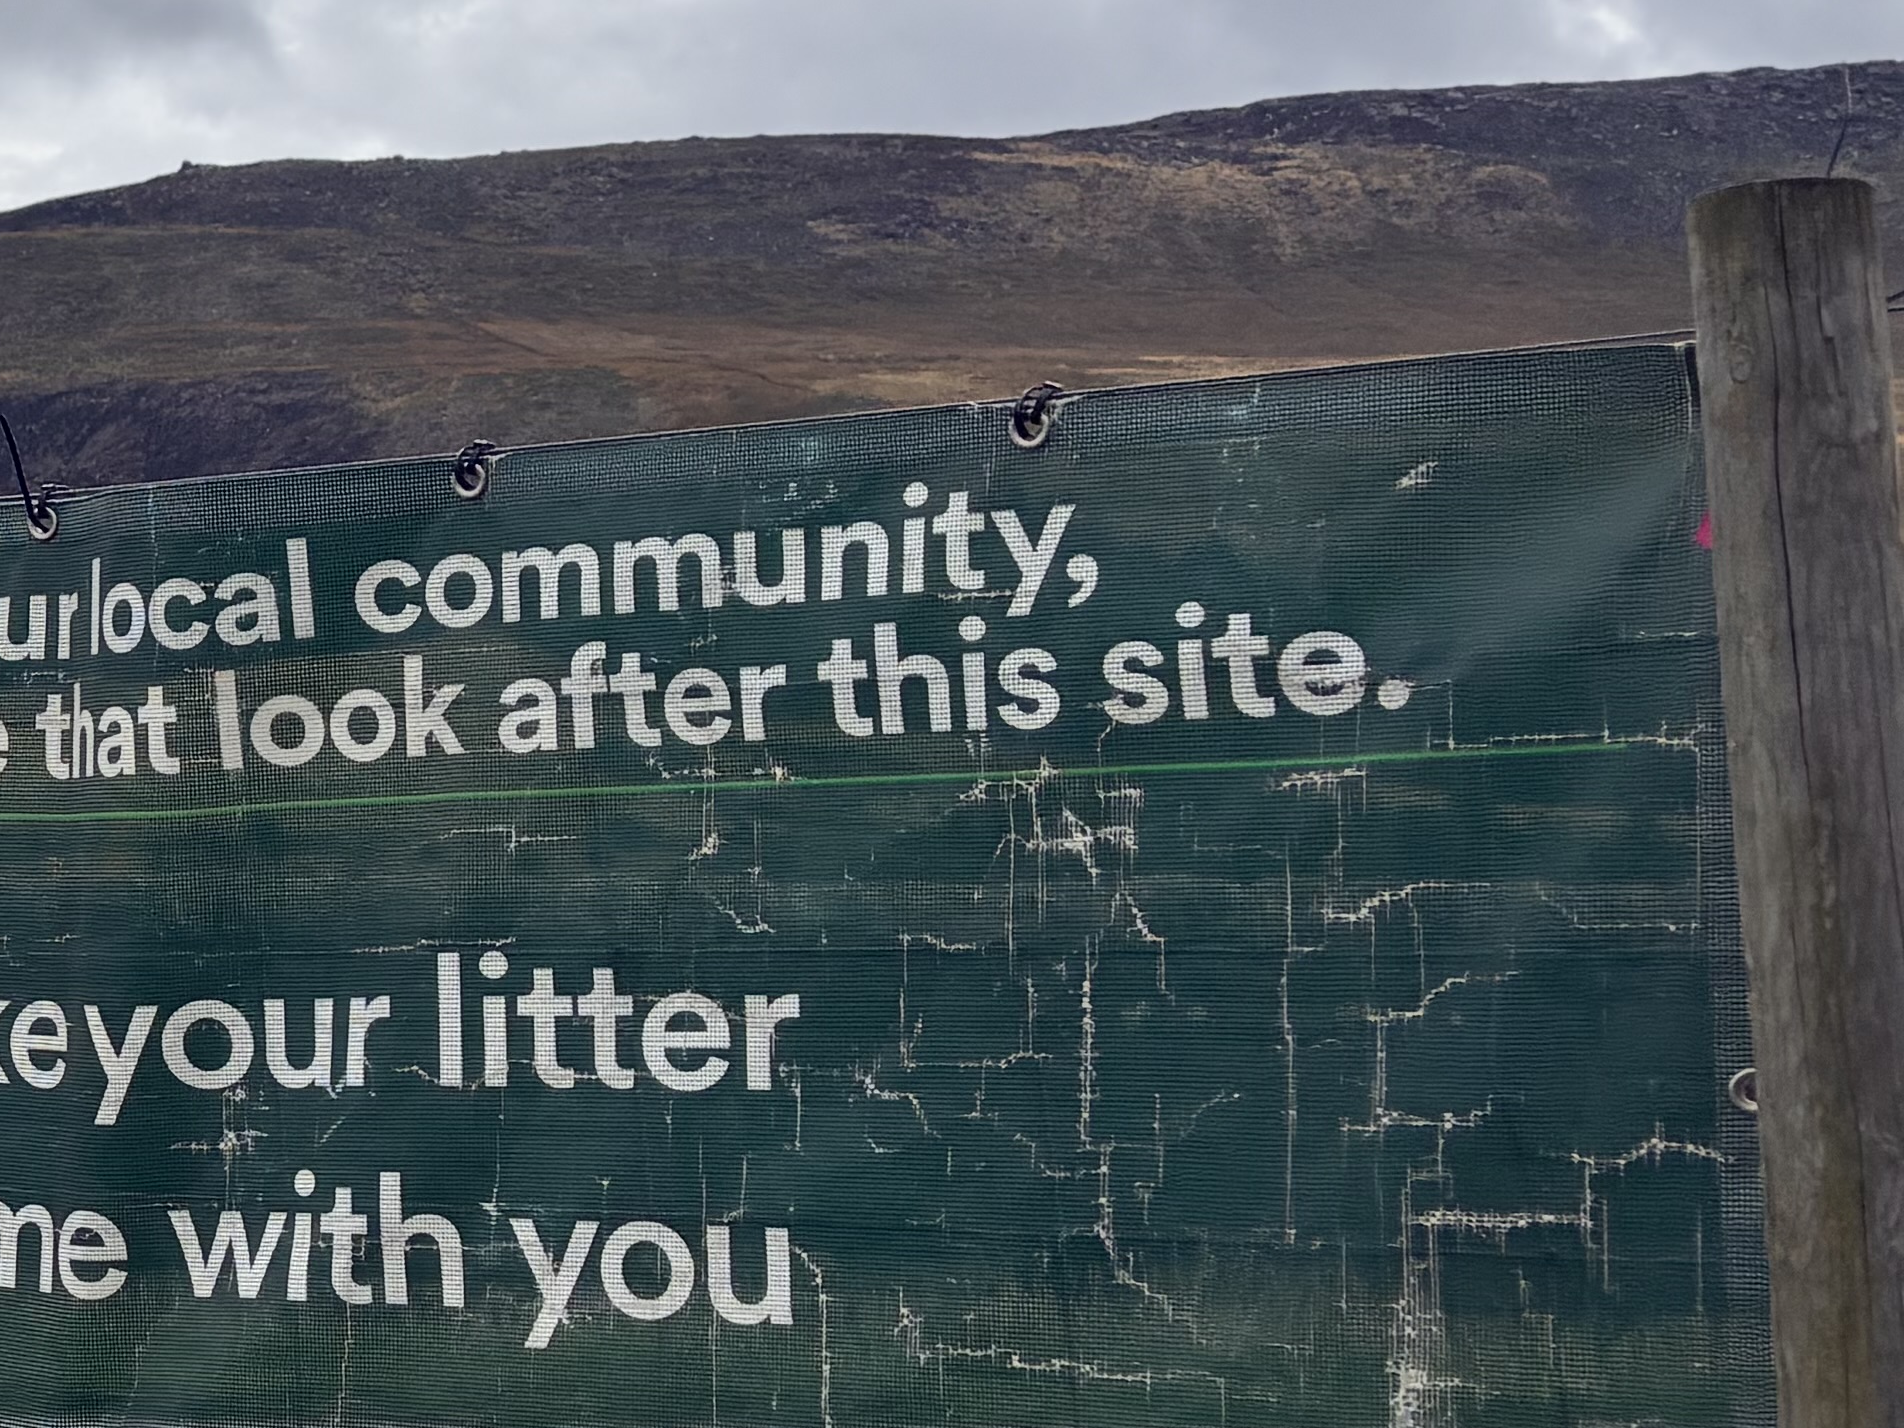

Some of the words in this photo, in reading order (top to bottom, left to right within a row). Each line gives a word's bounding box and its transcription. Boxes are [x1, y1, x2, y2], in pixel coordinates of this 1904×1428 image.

[91, 537, 315, 656] local
[355, 481, 1099, 635] community,
[36, 682, 182, 780] that
[214, 655, 470, 771] look
[497, 640, 788, 756] after
[817, 615, 1060, 738] this
[1103, 601, 1411, 726] site.
[80, 988, 391, 1126] your
[437, 949, 801, 1092] litter
[168, 1167, 465, 1307] with
[507, 1214, 795, 1349] you
